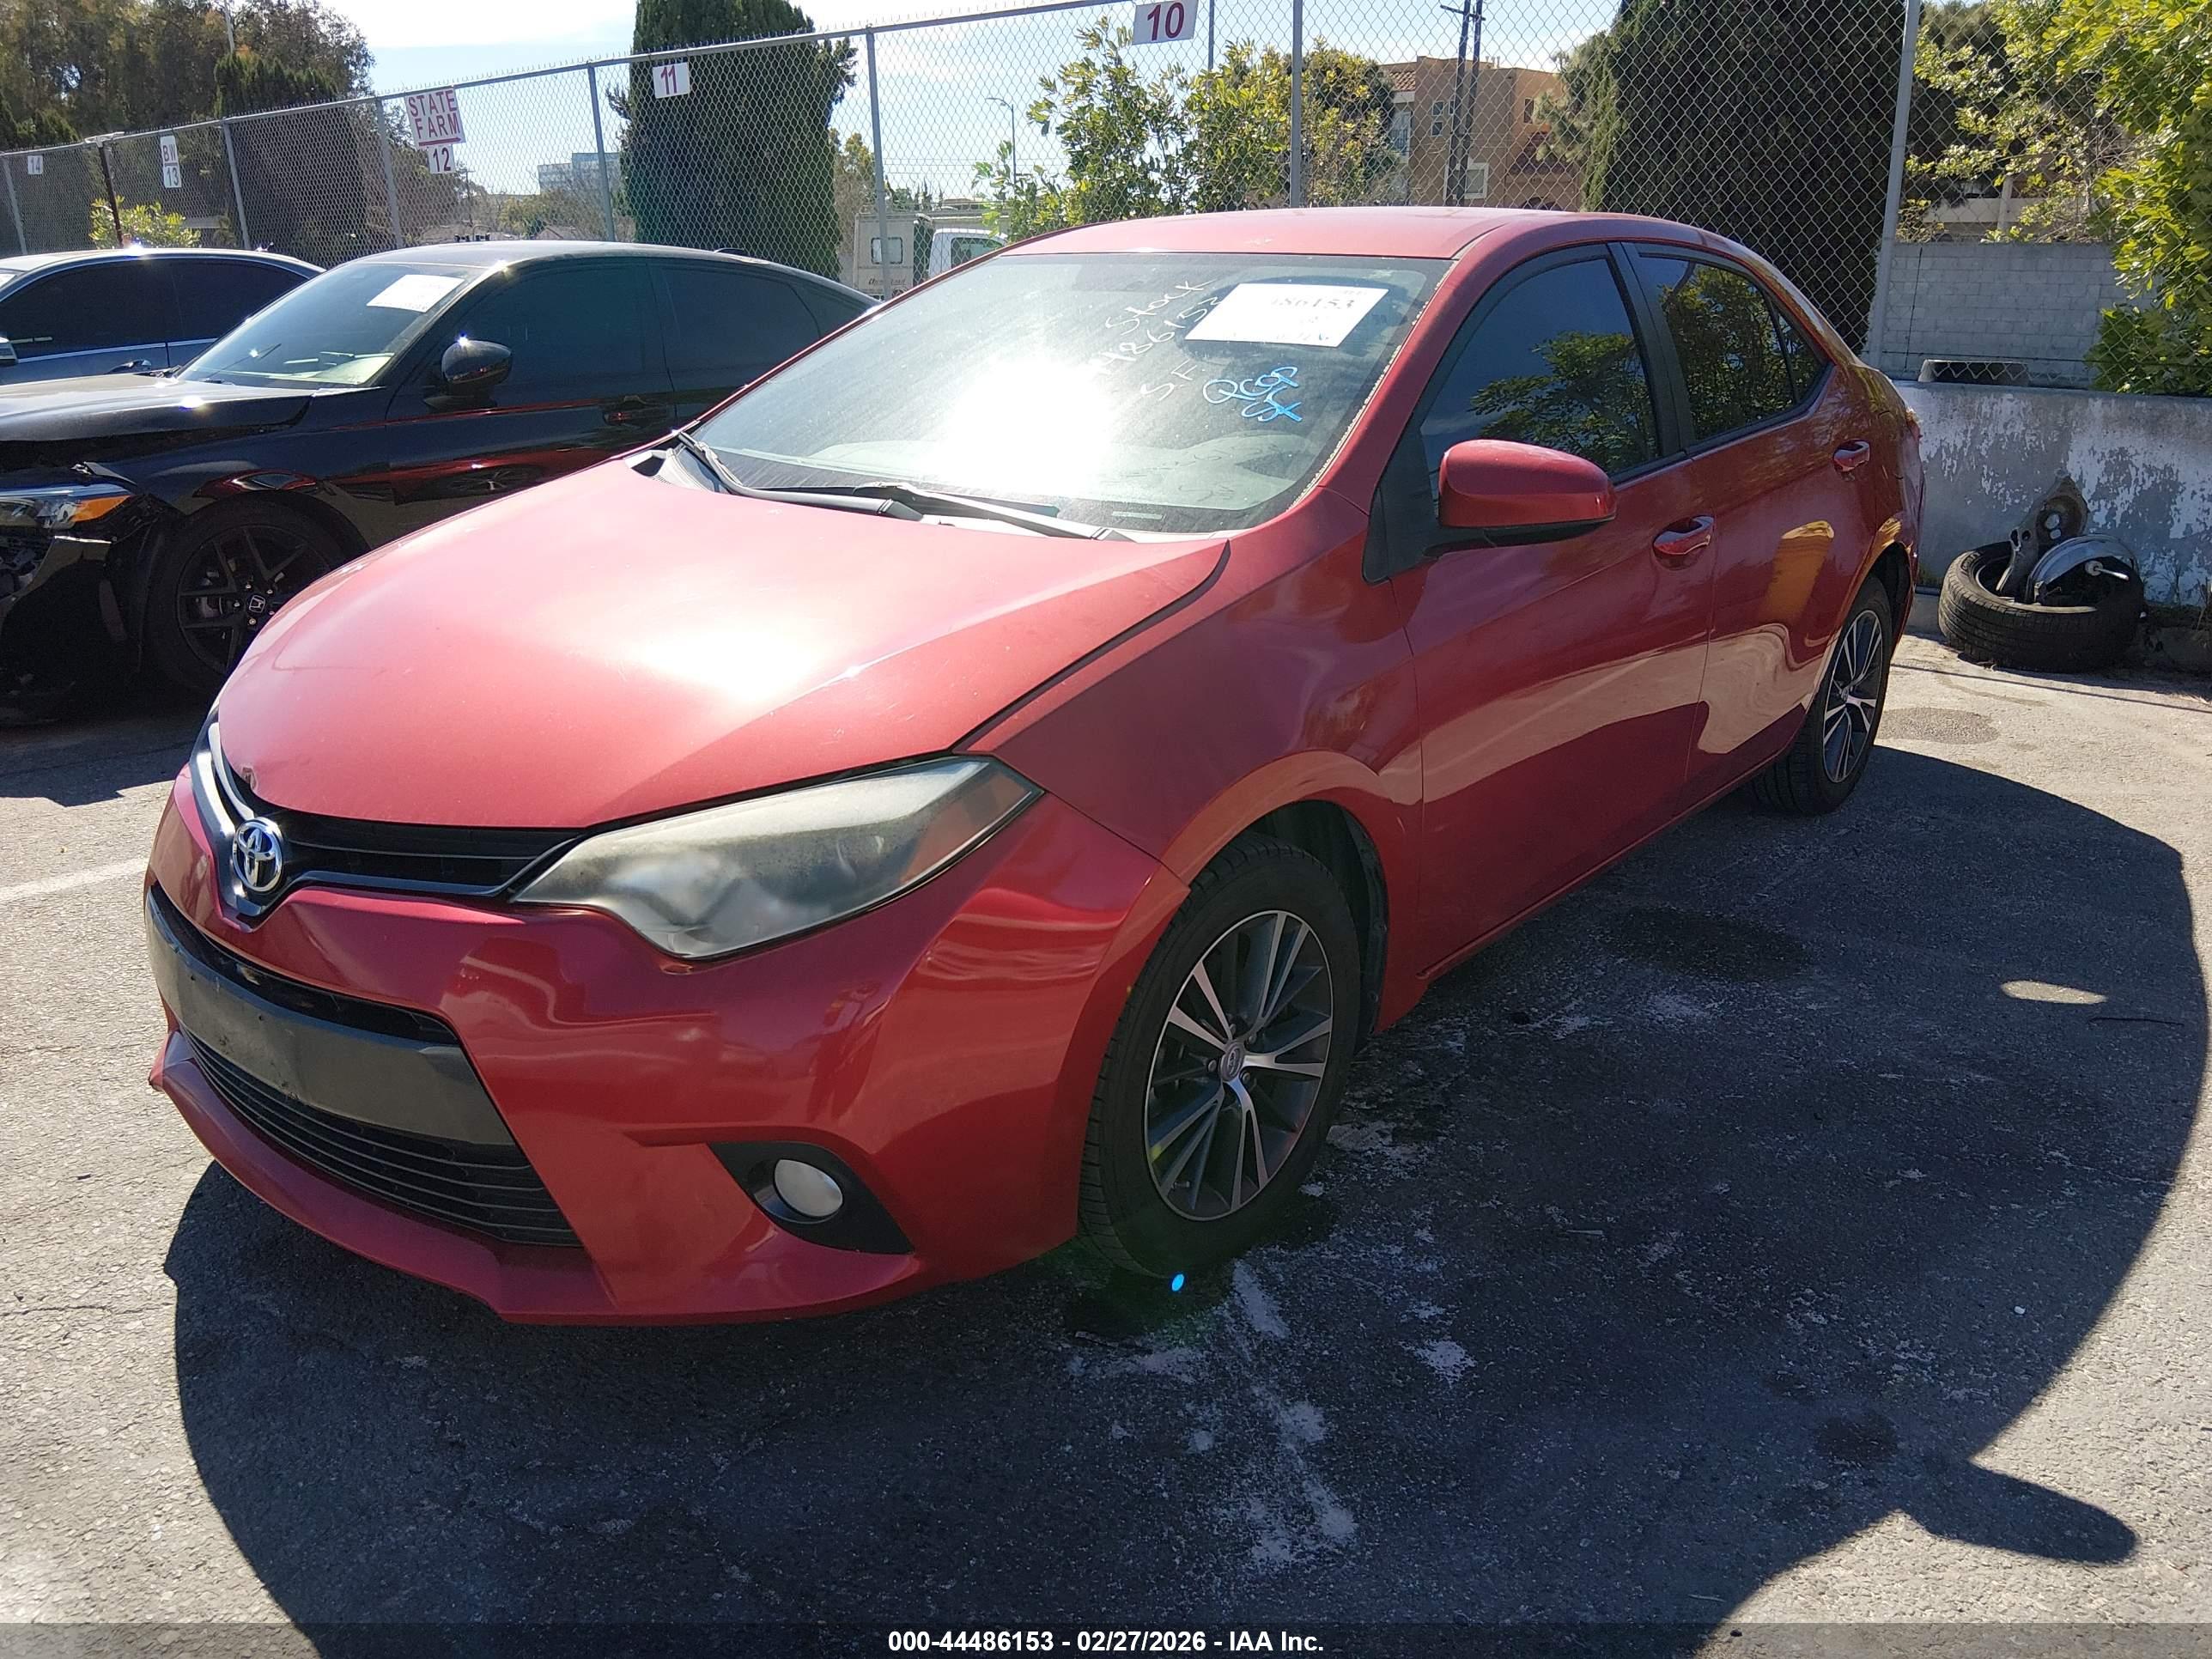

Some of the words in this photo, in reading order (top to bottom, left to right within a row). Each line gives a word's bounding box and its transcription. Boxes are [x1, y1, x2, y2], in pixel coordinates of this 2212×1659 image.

[1146, 3, 1185, 41] 10
[660, 64, 678, 94] 11
[408, 90, 458, 117] STATE
[415, 112, 460, 139] FARM
[30, 158, 41, 173] 14
[433, 148, 451, 172] 12
[166, 167, 179, 186] 13
